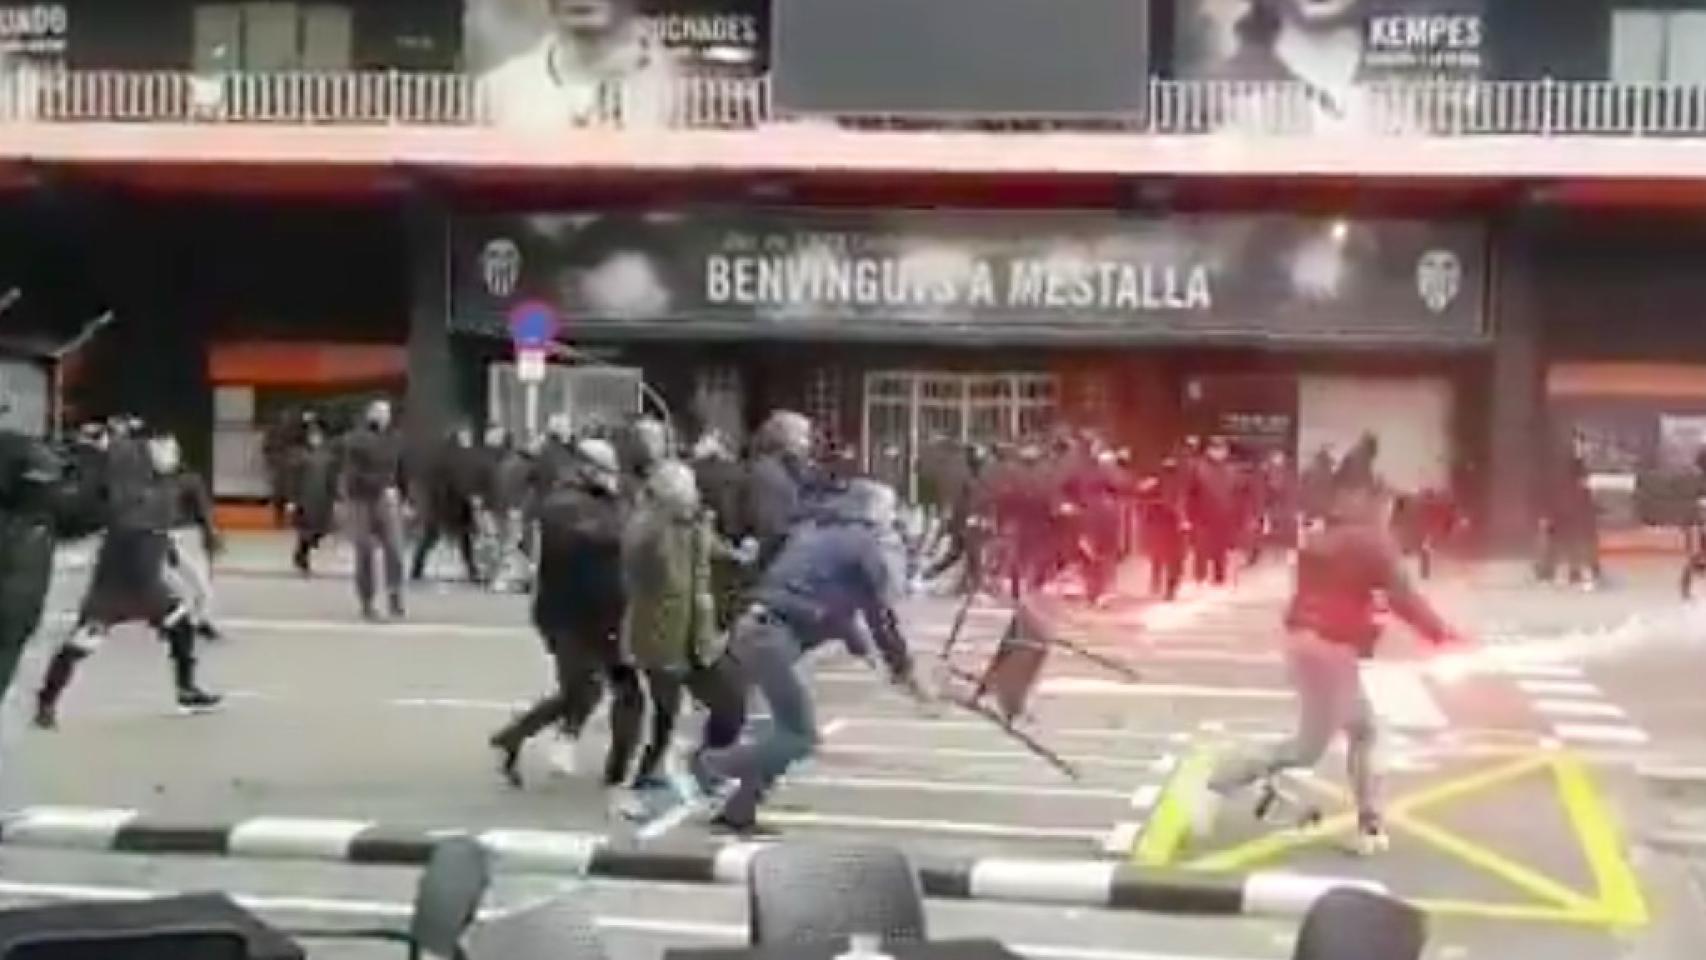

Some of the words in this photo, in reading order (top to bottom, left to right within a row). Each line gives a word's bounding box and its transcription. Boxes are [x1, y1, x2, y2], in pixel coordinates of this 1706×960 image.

[1370, 15, 1481, 47] KEMPES
[968, 258, 995, 306] A
[1008, 257, 1212, 309] MESTALLA
